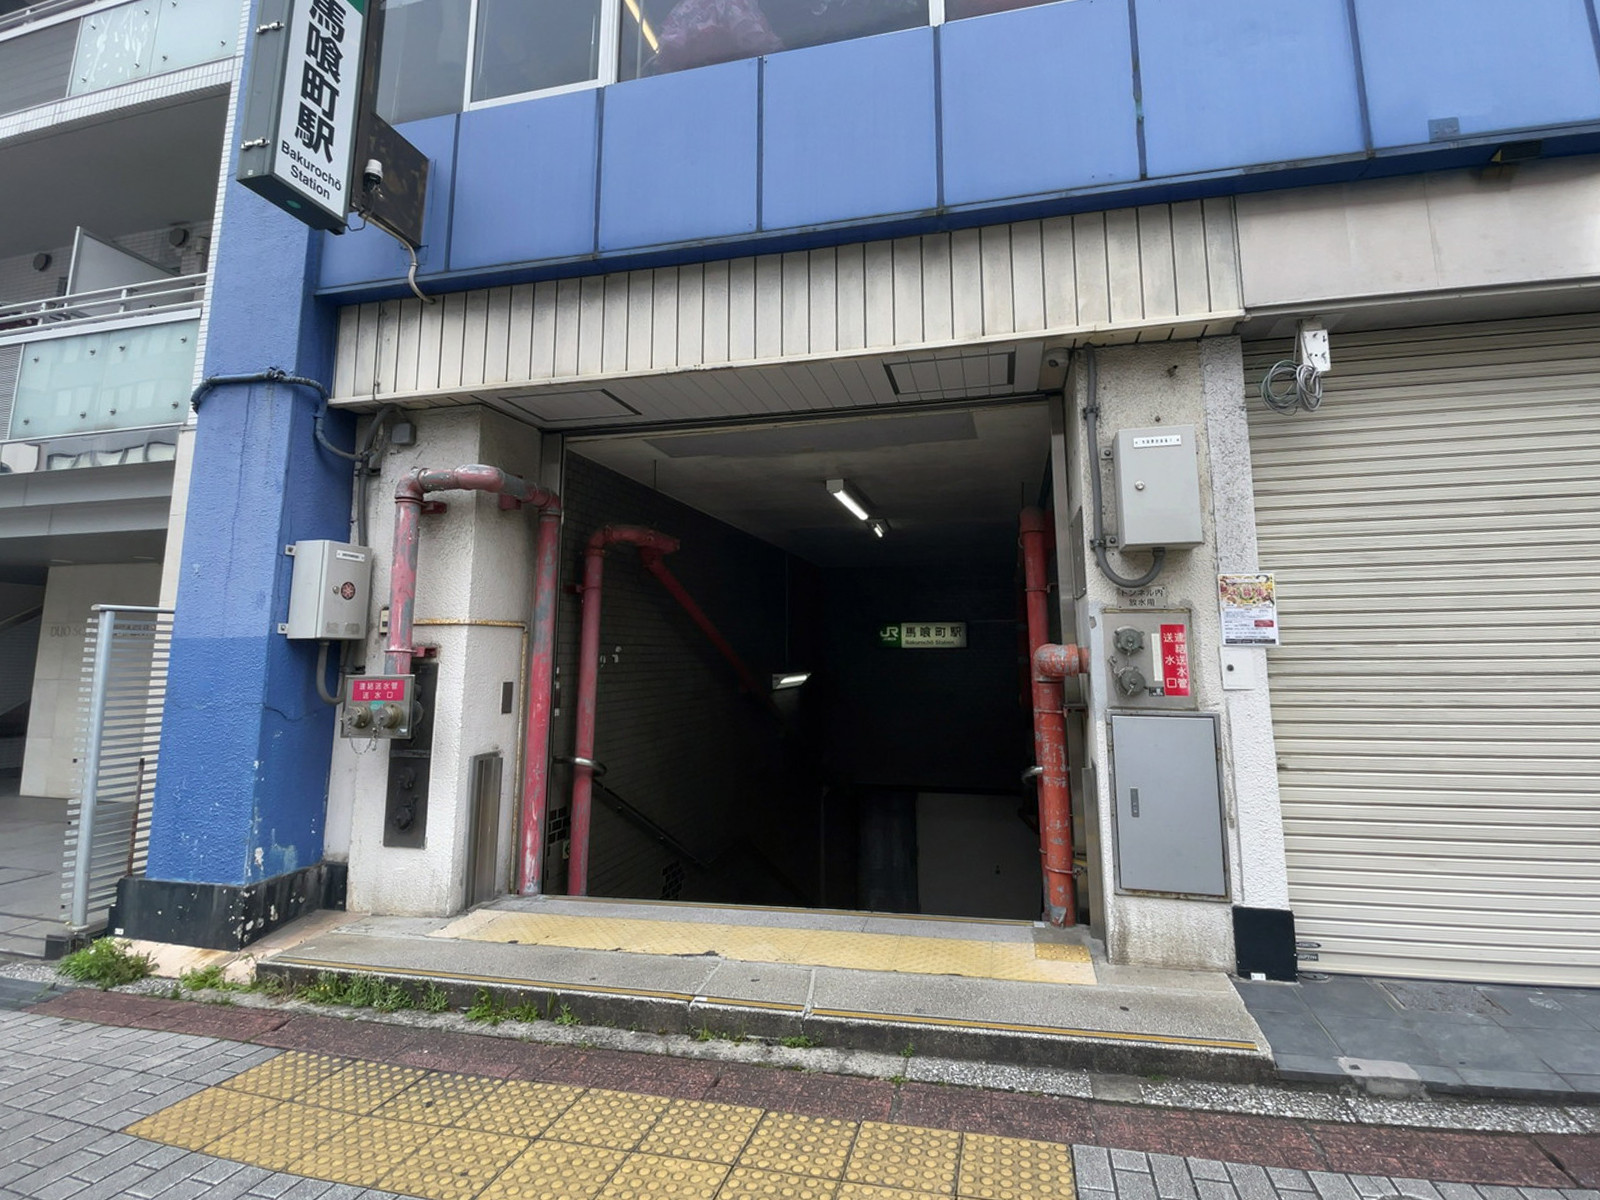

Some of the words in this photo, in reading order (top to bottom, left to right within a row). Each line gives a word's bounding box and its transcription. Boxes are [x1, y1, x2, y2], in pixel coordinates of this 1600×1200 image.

[294, 0, 347, 164] 馬喰町駅
[290, 164, 331, 200] Station
[880, 626, 899, 637] JR
[905, 626, 962, 638] 馬喰町駅
